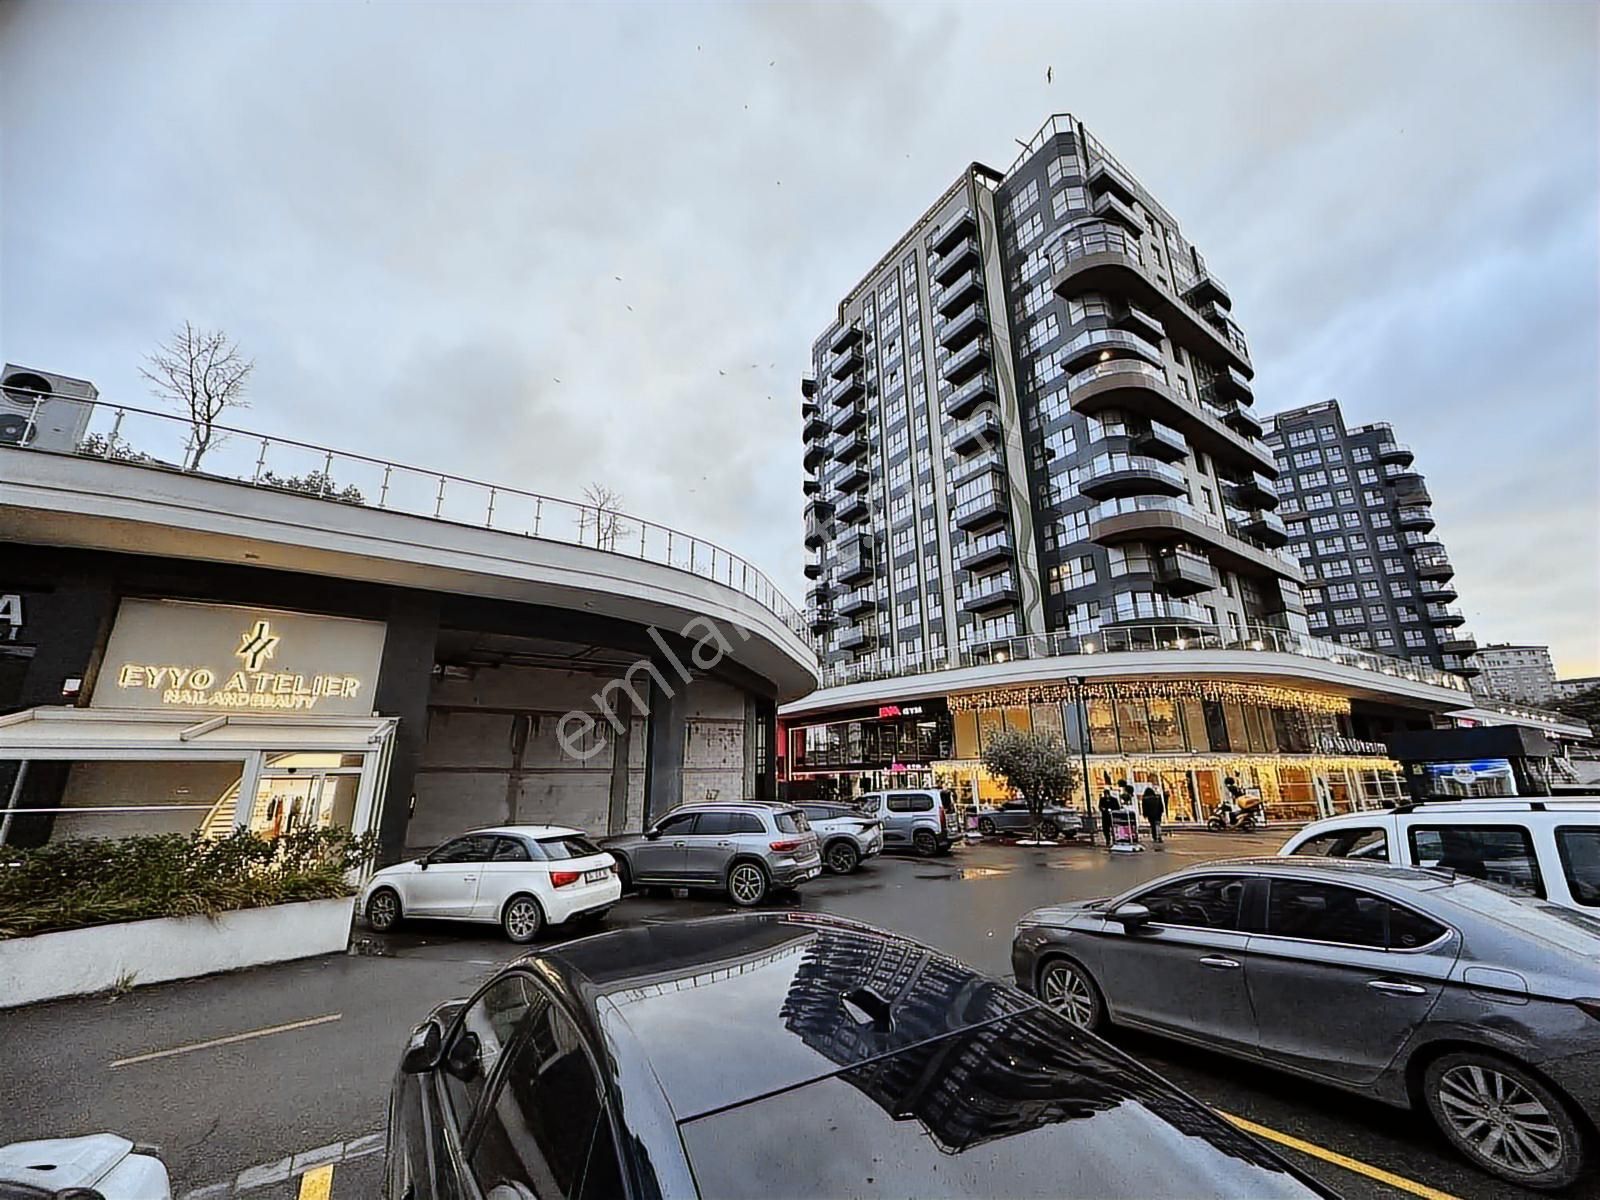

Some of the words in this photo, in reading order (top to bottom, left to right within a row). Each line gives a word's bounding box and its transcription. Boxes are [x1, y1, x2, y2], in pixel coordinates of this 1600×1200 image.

[118, 663, 215, 690] EYYO
[224, 670, 361, 698] ATELIER
[163, 688, 207, 706] NAIL
[207, 690, 247, 707] AND
[249, 691, 318, 710] BEAUTY
